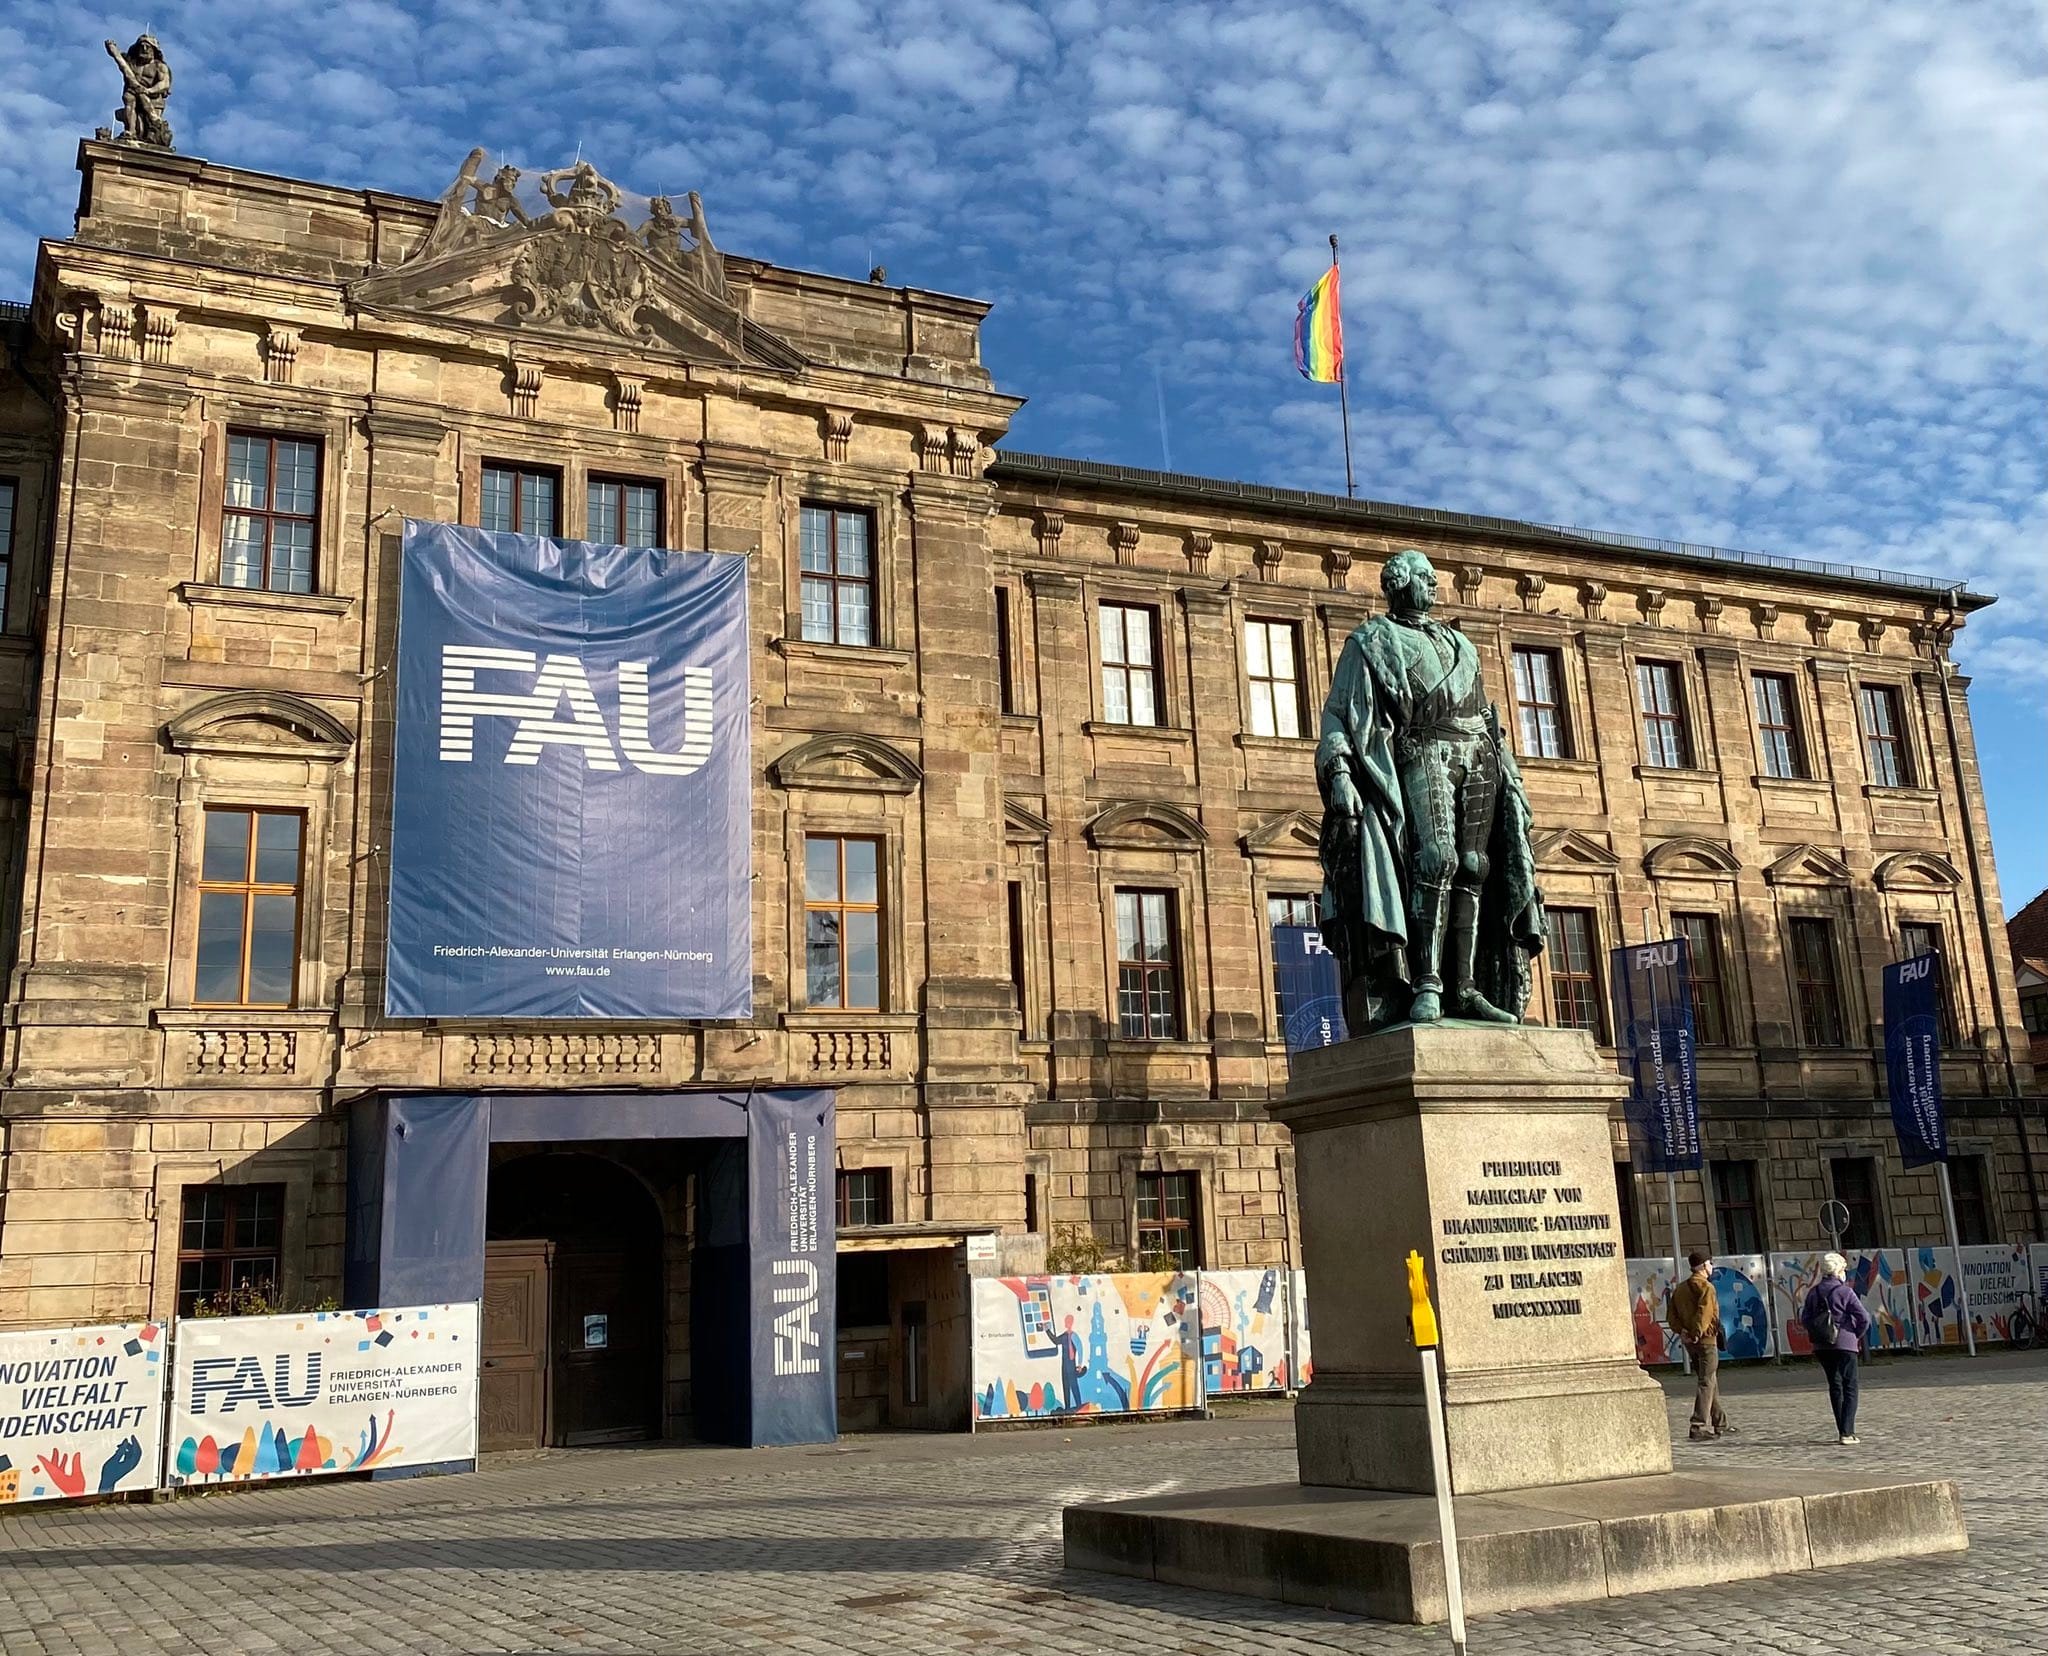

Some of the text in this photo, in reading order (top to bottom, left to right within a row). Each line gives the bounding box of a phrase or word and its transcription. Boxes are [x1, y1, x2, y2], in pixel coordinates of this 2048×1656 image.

[440, 645, 713, 775] FAU
[433, 945, 713, 963] Friedrich-Alexander-Universität Erlangen-Nürnberg
[1636, 944, 1679, 970] FAU
[546, 965, 611, 977] www.fau.de
[1900, 958, 1931, 984] FAU
[1651, 1028, 1676, 1156] Friedrich-Alexander
[1669, 1084, 1688, 1155] Universität
[1482, 1161, 1562, 1177] FRIEDRICH
[788, 1132, 798, 1253] FRIEDRICH-ALEXANDER
[807, 1135, 817, 1251] ERLANGEN-NÜRNBERG
[1467, 1187, 1583, 1206] MARKGRAF VON
[799, 1185, 808, 1252] UNIVERSITÄT
[1503, 1245, 1530, 1262] DER
[1484, 1271, 1583, 1291] ZU ERLANGEN
[1980, 1276, 2016, 1290] VIELFALT
[773, 1259, 820, 1376] FAU
[191, 1352, 321, 1414] FAU
[329, 1362, 462, 1381] FRIEDRICH-ALEXANDER
[329, 1376, 403, 1393] UNIVERSITÄT
[22, 1381, 128, 1410] VIELFALT
[328, 1385, 458, 1405] ERLANGEN-NÜRNBERG
